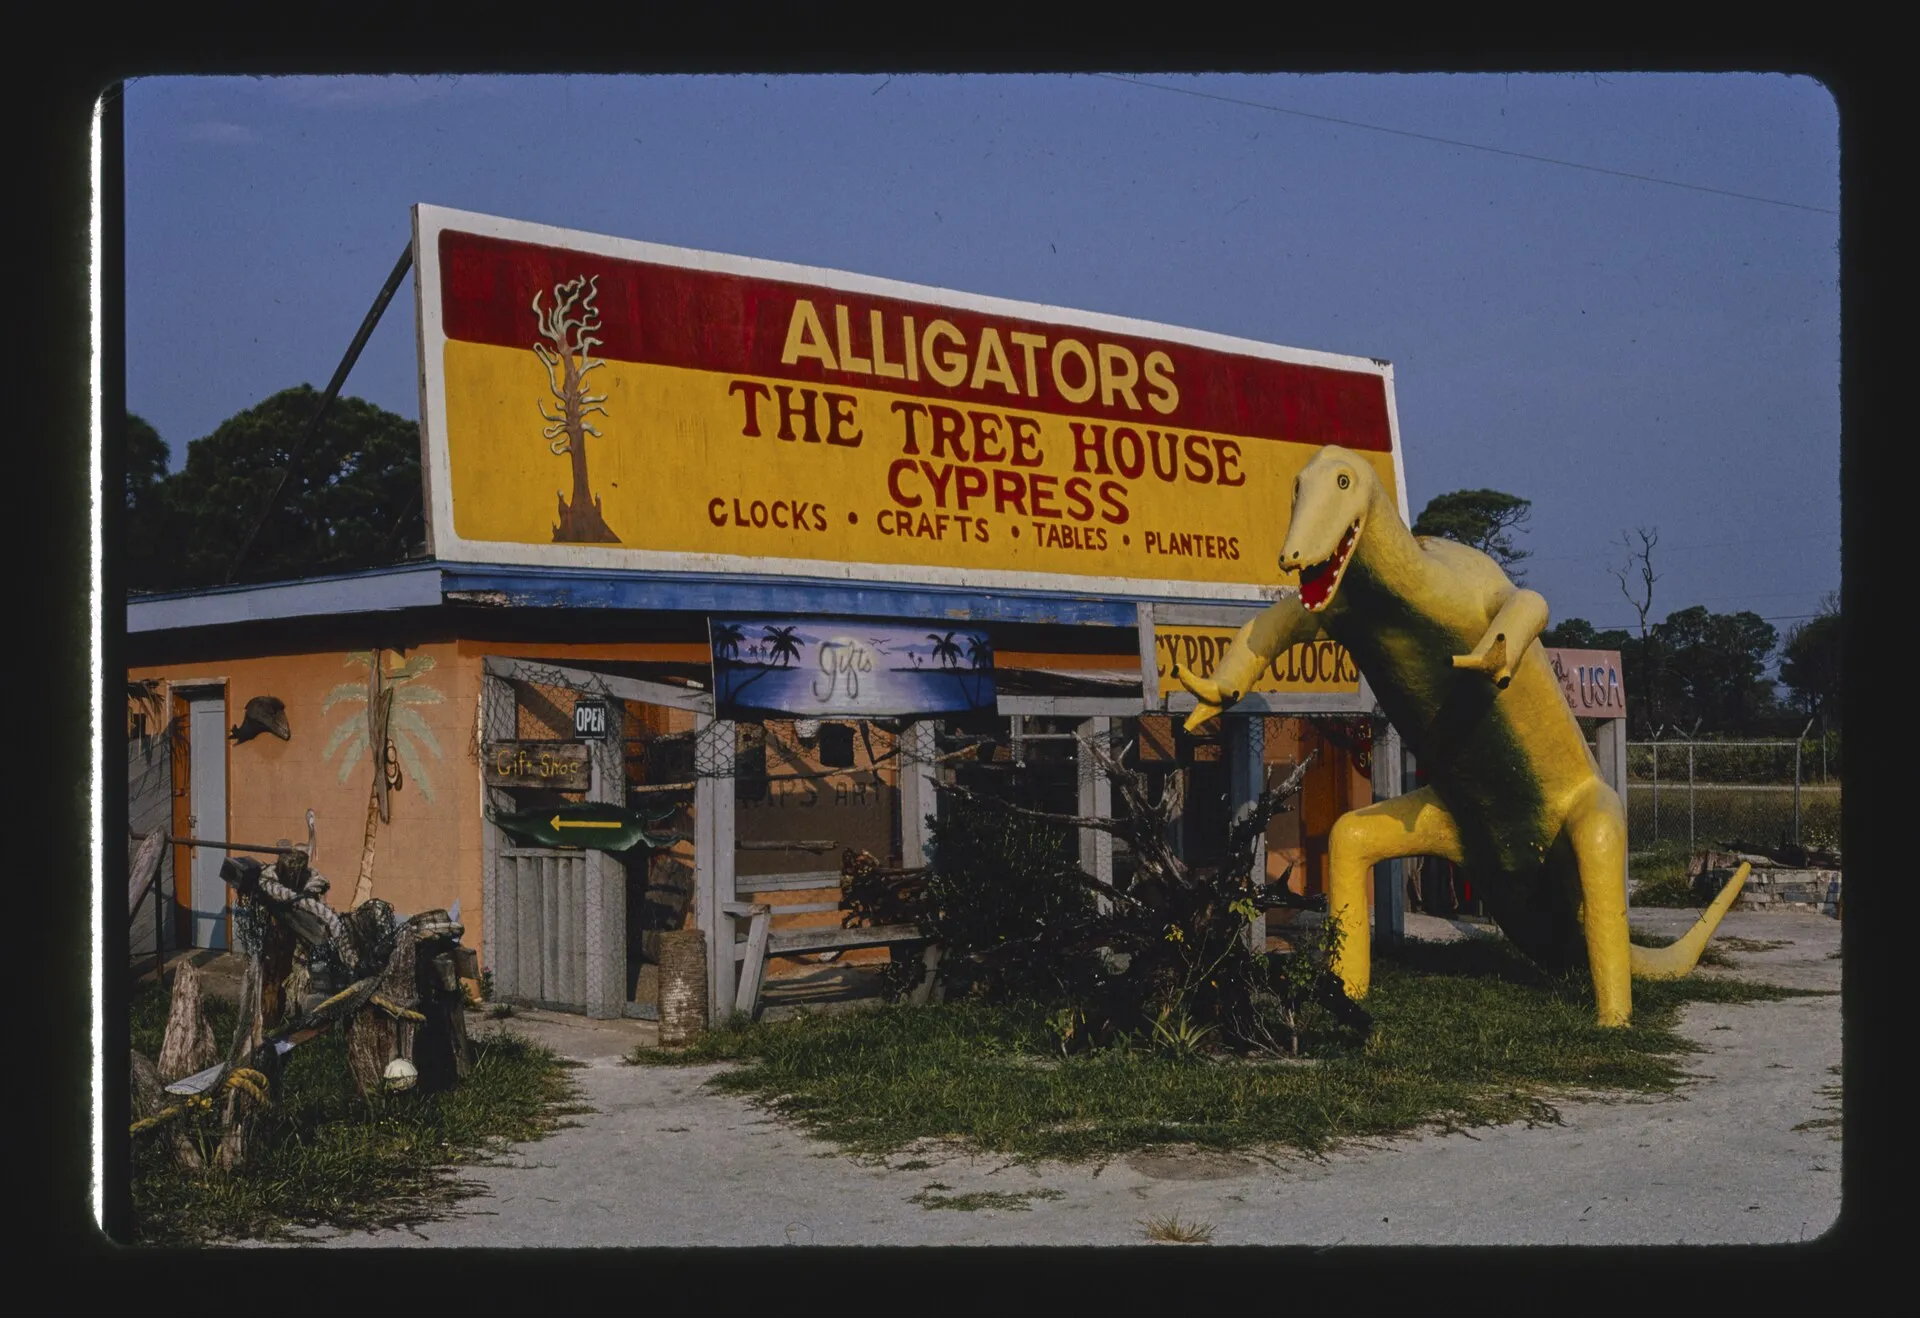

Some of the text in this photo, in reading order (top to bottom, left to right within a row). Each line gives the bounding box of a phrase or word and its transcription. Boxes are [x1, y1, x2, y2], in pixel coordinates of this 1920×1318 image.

[781, 300, 1179, 414] ALLIGATORS
[729, 380, 1246, 487] THE TREE HOUSE
[887, 459, 1130, 525] CYPRESS
[708, 498, 1240, 560] CLOCKS CRAFTS TABLES PLANTERS
[812, 641, 873, 703] gifts
[1579, 666, 1623, 708] USA
[576, 707, 605, 732] OPEN
[540, 754, 578, 784] Shop
